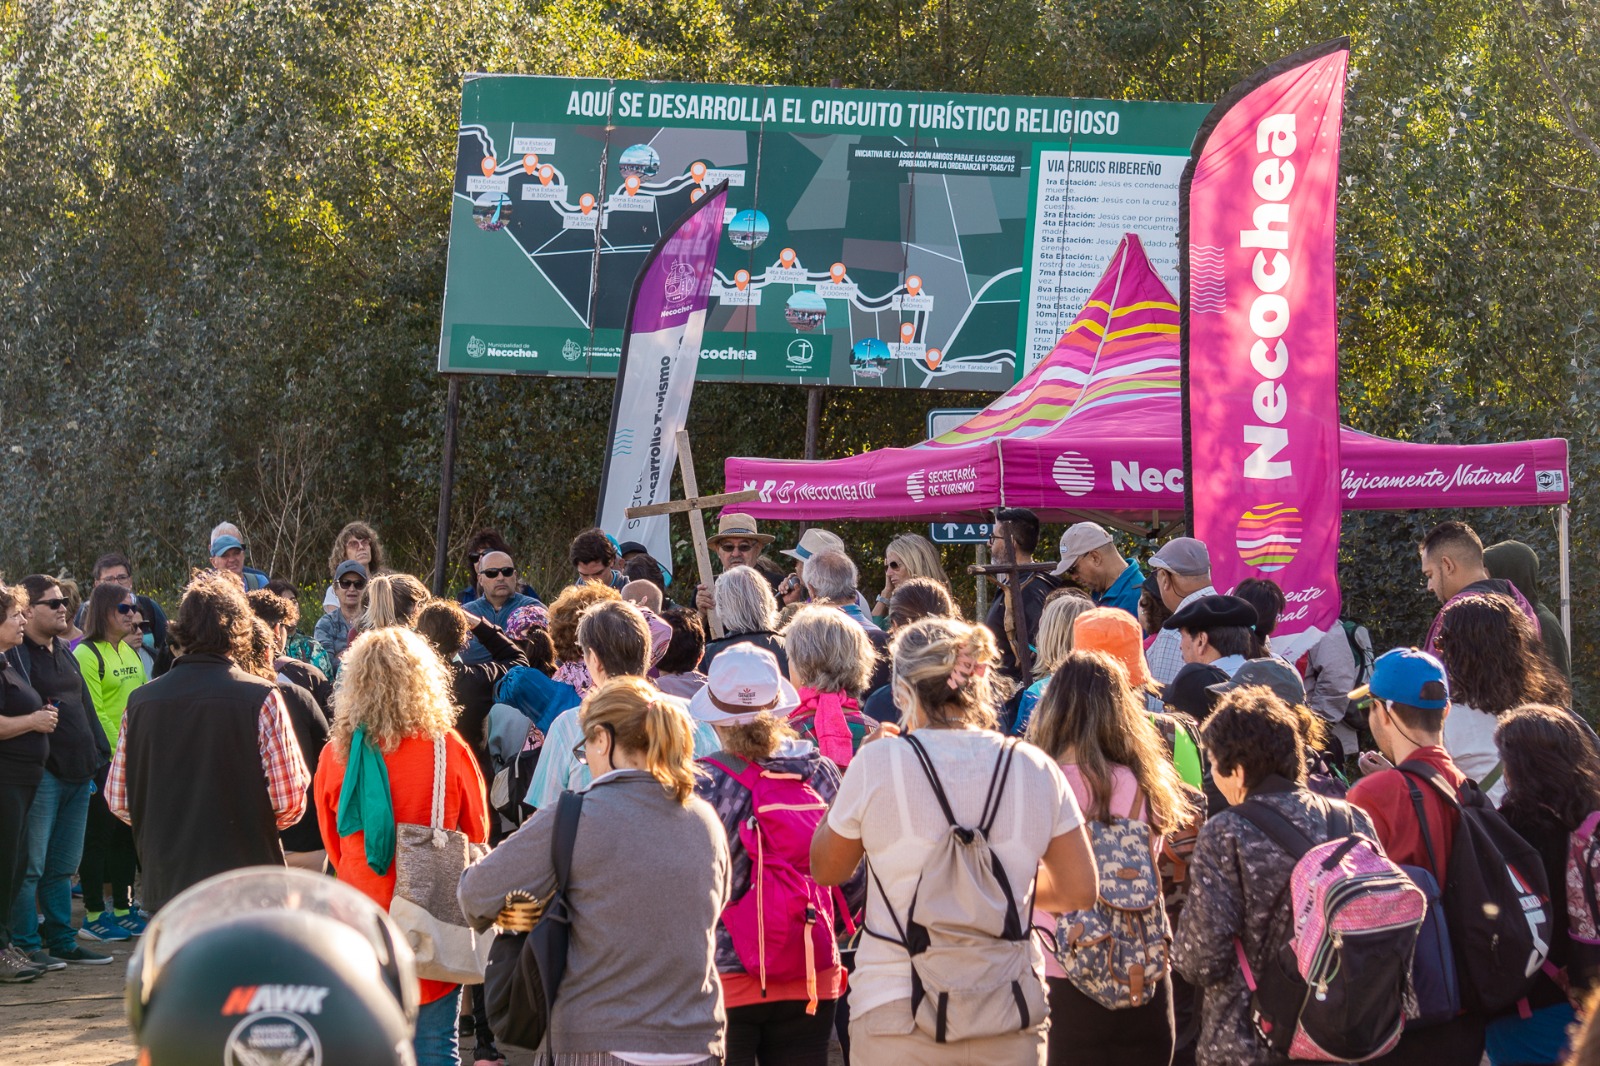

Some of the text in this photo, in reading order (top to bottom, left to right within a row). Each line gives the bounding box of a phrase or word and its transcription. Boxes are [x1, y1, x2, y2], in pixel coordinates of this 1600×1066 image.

[566, 87, 1120, 136] AQUÍ SE DESARROLLA EL CIRCUITO TURÍSTICO RELIGIOSO
[854, 149, 883, 158] INICIATIVA
[883, 150, 891, 159] DE
[892, 150, 899, 159] LA
[931, 152, 953, 161] AMIGOS
[953, 153, 975, 162] PARAJE
[975, 154, 986, 163] LAS
[986, 155, 1016, 163] CASCADAS
[928, 161, 939, 169] POR
[940, 161, 947, 169] LA
[947, 162, 981, 171] ORDENANZA
[1047, 159, 1162, 176] VIA CRUCIS RIBEREÑO
[1059, 179, 1097, 187] Estación:
[1098, 180, 1121, 188] Jesús
[1062, 195, 1099, 203] Estación:
[1101, 196, 1123, 204] Jesús
[1058, 211, 1096, 219] Estación:
[1042, 219, 1056, 227] 4ta
[1058, 220, 1096, 228] Estación:
[1133, 223, 1174, 231] encuentra
[1041, 235, 1055, 243] 5ta
[1056, 236, 1094, 244] Estación:
[1056, 253, 1093, 261] Estación:
[1058, 270, 1095, 278] Estación:
[1054, 286, 1092, 294] Estación:
[1240, 112, 1297, 480] Necochea
[1036, 302, 1051, 310] 9na
[487, 348, 539, 358] Necochea
[699, 346, 757, 361] cochea
[928, 464, 977, 484] SECRETARÍA
[1443, 463, 1525, 492] Natural
[928, 481, 975, 497] DE TURISMO
[964, 524, 976, 535] A
[221, 984, 330, 1016] HAWK
